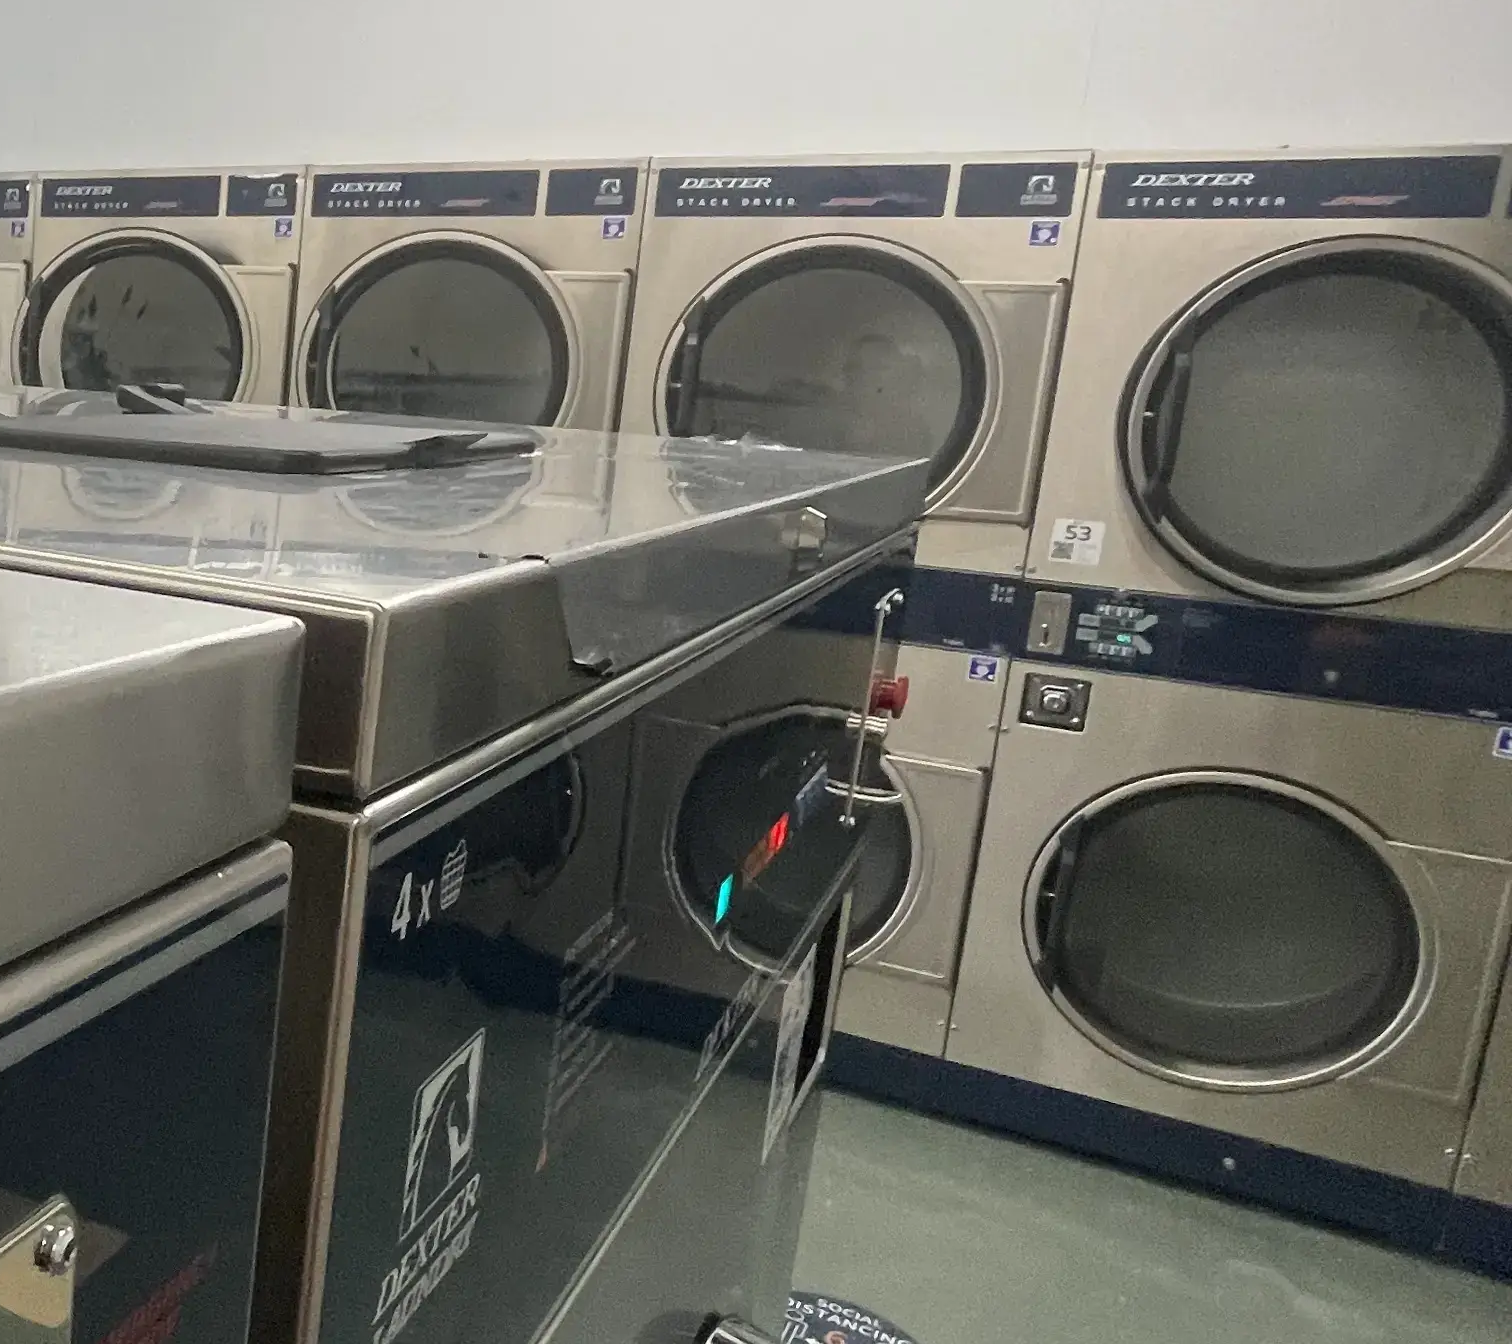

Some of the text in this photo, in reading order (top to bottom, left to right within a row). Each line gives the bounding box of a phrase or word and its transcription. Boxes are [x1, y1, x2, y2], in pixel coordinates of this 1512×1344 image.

[330, 181, 403, 193] DEXTER
[679, 176, 772, 190] DEXTER
[1130, 172, 1256, 187] DEXTER
[1126, 196, 1286, 207] STACK DRYER
[1064, 524, 1093, 542] 53
[371, 1172, 481, 1326] DEXTER
[817, 1298, 882, 1328] SOCIAL
